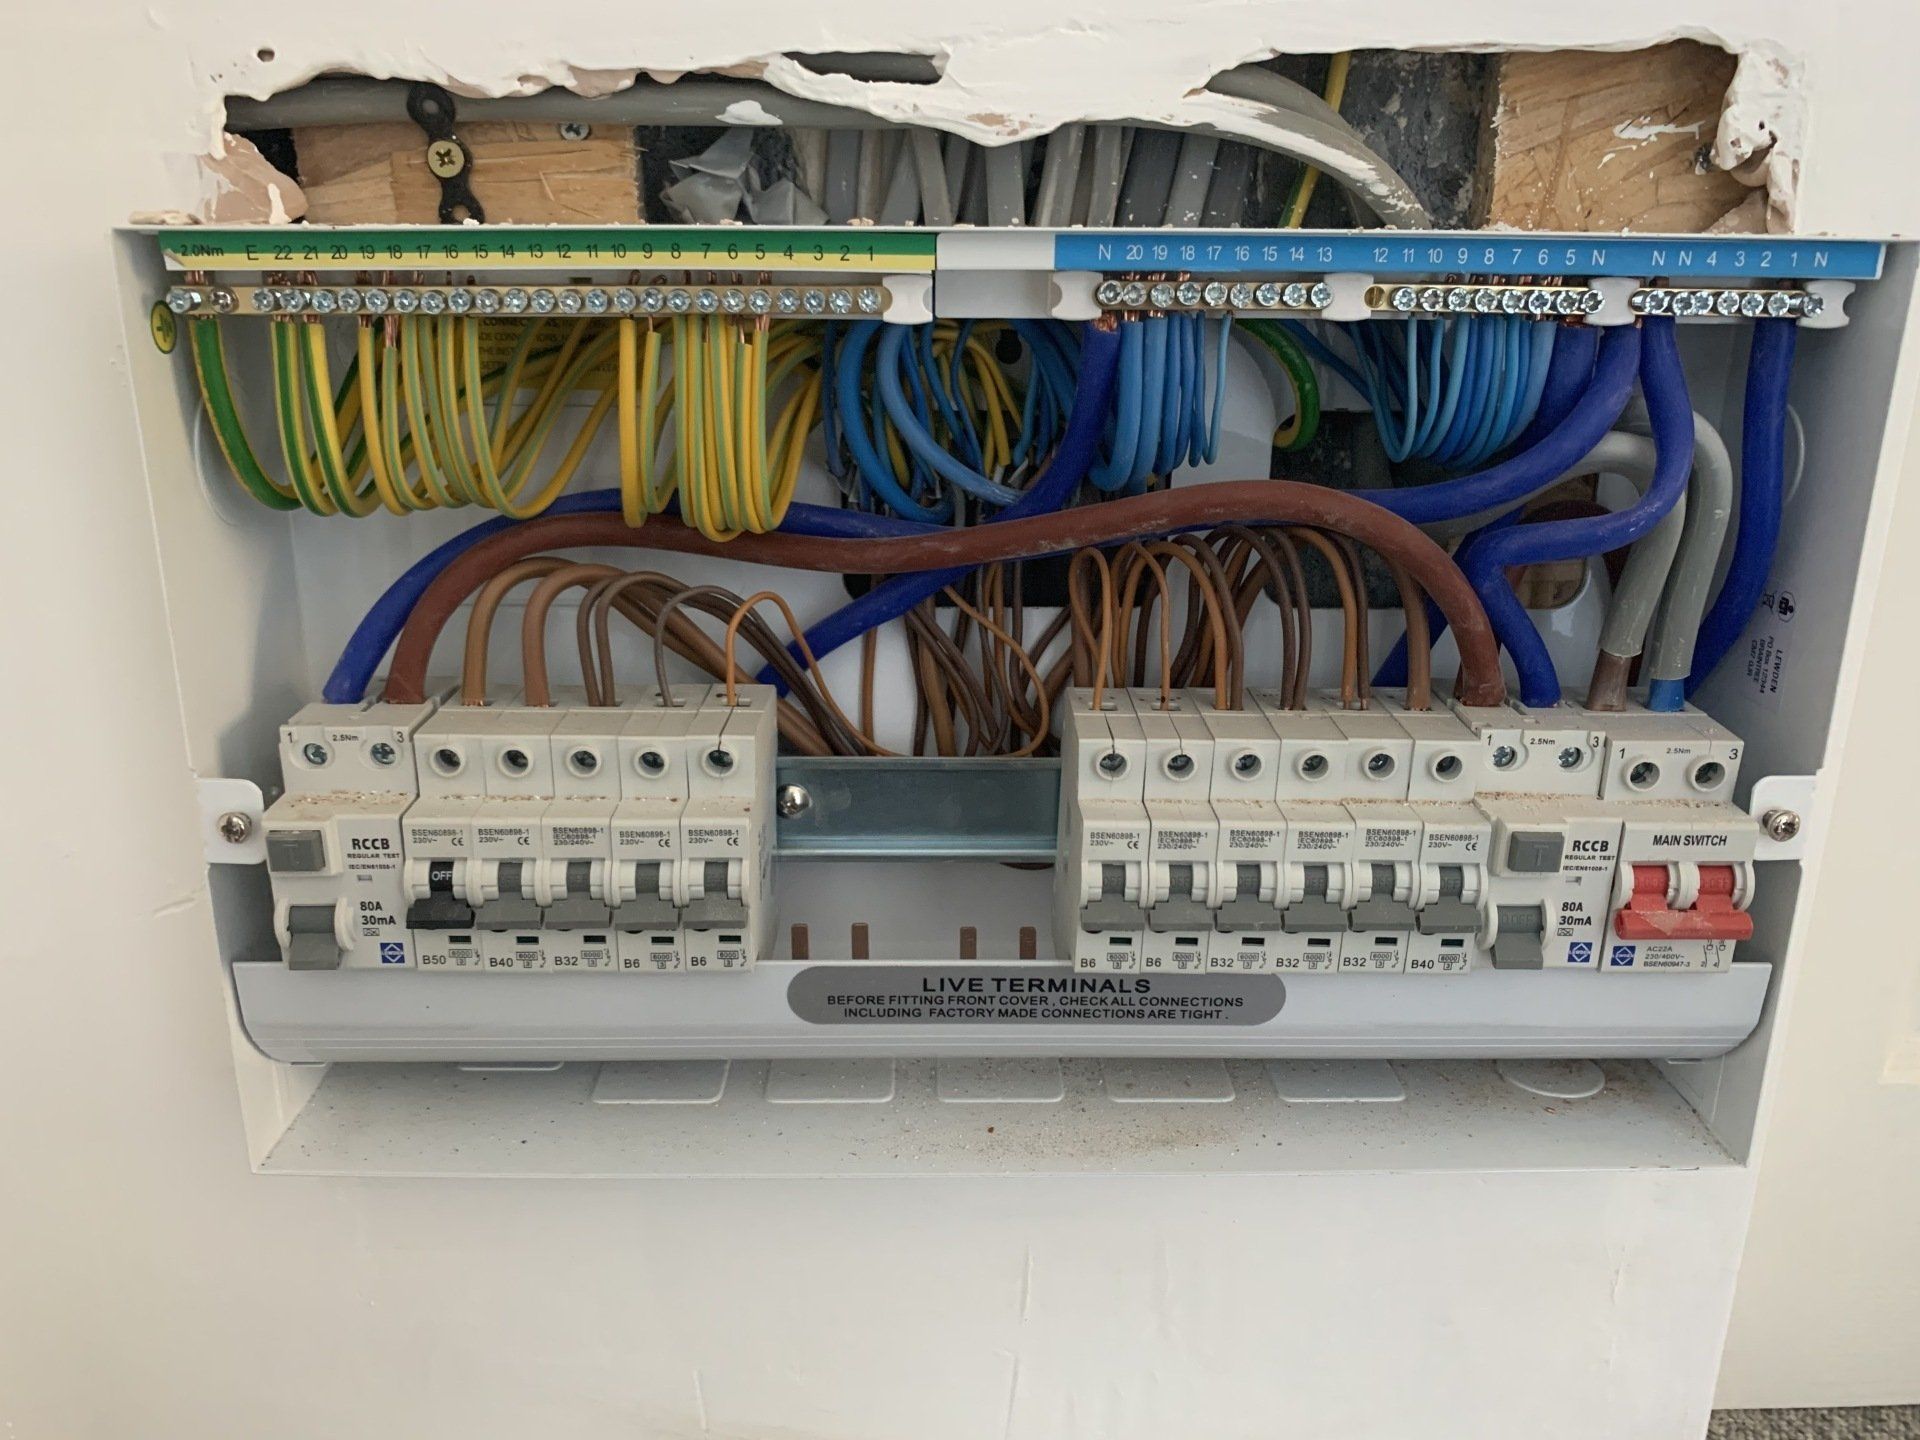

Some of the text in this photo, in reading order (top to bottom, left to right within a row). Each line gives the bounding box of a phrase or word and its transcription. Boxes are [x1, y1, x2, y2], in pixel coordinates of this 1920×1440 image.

[181, 244, 874, 260] 2.0Nm E 22 21 20 19 18 17 16 15 14 13 12 11 10 9 8 7 6 5 4 3 2 1
[1099, 244, 1605, 265] N 20 19 18 17 16 15 14 13 12 11 10 9 8 7 6 5 N
[1652, 251, 1827, 267] N N 4 3 2 1 N
[287, 731, 404, 743] 1 2.5Nm 3
[1486, 735, 1600, 748] 1 2.5Nm 3
[1618, 747, 1738, 760] 1 2.5Nm 3
[352, 838, 390, 850] RCCB
[1572, 840, 1609, 852] RCCB
[1652, 835, 1728, 847] MAIN SWITCH
[432, 871, 453, 881] OFF
[360, 901, 382, 911] 80A
[1561, 901, 1583, 912] 80A
[362, 915, 396, 925] 30mA
[1559, 915, 1592, 926] 30mA
[423, 955, 446, 964] B50
[490, 958, 513, 967] B40
[554, 956, 578, 966] B32
[624, 959, 640, 968] B6
[691, 957, 707, 966] B6
[1080, 958, 1096, 968] B6
[1146, 957, 1161, 967] B6
[1211, 958, 1234, 967] B32
[1276, 958, 1299, 968] B32
[1343, 957, 1366, 967] B32
[1411, 960, 1434, 969] B40
[922, 977, 1150, 994] LIVE TERMINALS
[827, 995, 885, 1006] BEFORE
[888, 995, 944, 1006] FITTING
[947, 995, 997, 1006] FRONT
[1059, 996, 1109, 1006] CHECK
[1111, 996, 1137, 1006] ALL
[1139, 997, 1244, 1007] CONNECTIONS
[844, 1008, 922, 1018] INCLUDING
[929, 1008, 995, 1018] FACTORY
[998, 1008, 1037, 1018] MADE
[1042, 1008, 1145, 1018] CONNECTIONS
[1147, 1009, 1176, 1019] ARE
